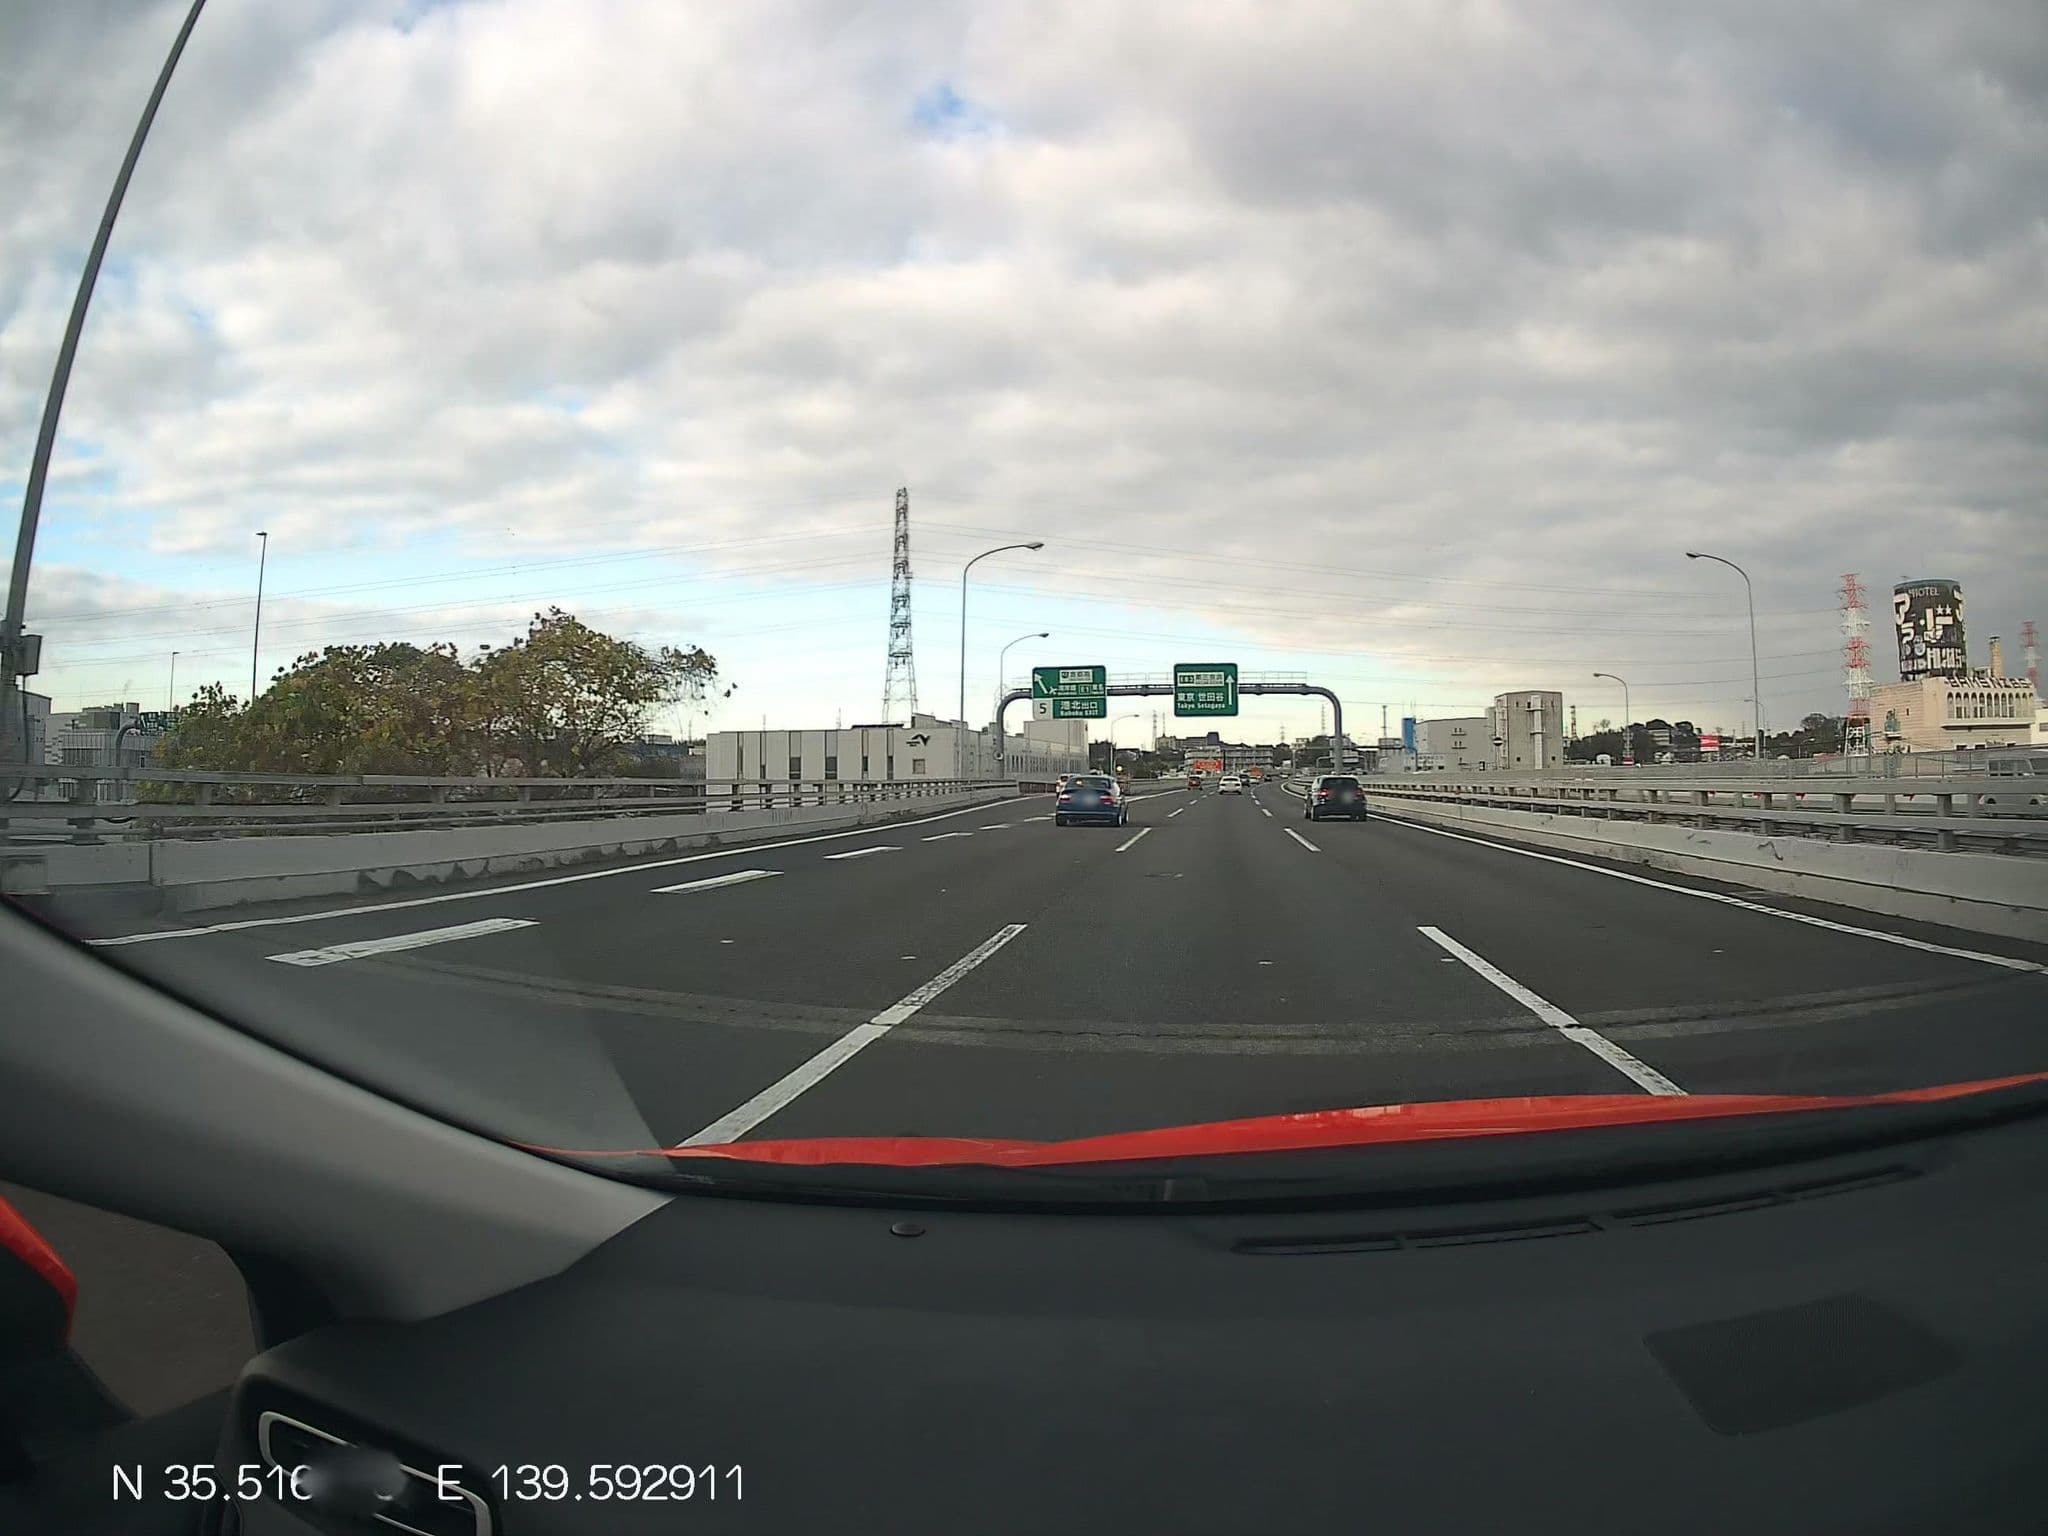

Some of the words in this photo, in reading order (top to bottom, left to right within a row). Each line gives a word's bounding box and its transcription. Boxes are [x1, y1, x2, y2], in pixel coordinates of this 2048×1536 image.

[1178, 692, 1195, 702] 東京
[1198, 692, 1224, 702] 世田谷
[1039, 702, 1047, 715] 5
[1060, 700, 1098, 710] 港北出口
